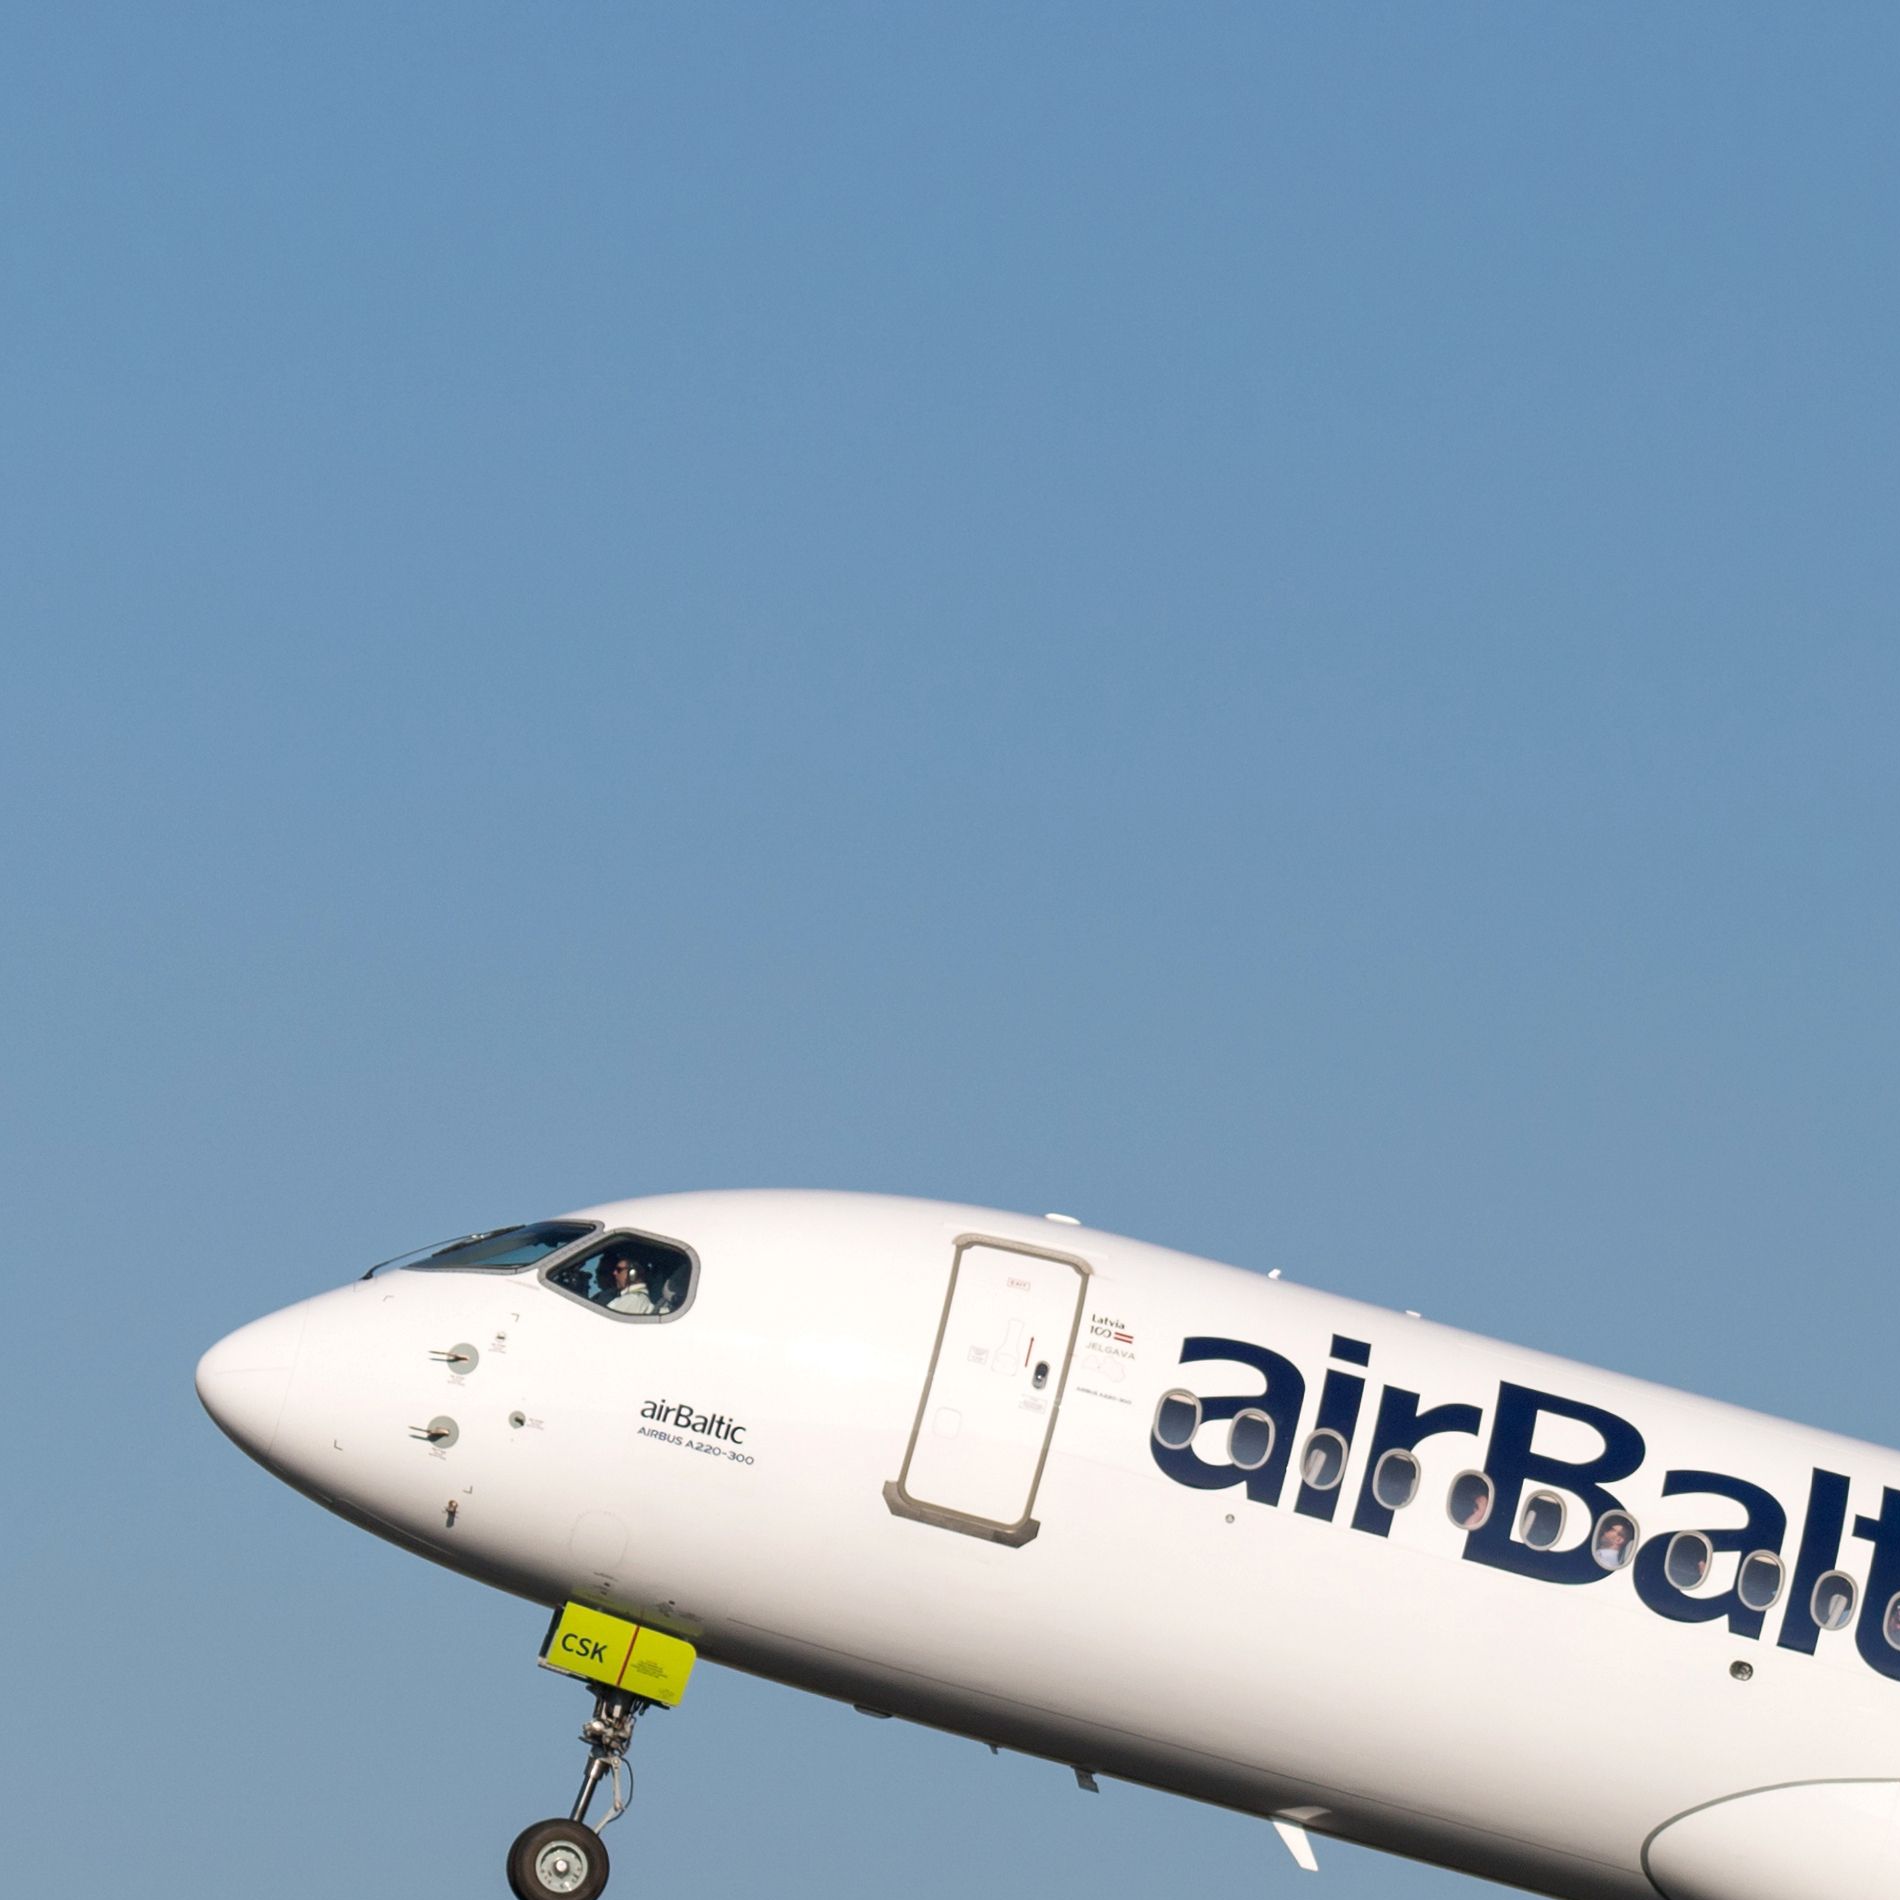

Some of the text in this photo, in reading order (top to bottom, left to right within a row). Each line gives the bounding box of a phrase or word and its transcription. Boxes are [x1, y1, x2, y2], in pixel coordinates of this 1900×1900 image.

[1091, 1312, 1125, 1329] Latvia
[1085, 1341, 1136, 1361] JELGAVA
[639, 1399, 747, 1445] airBaltic
[636, 1426, 756, 1466] AIRBUS A220-300
[561, 1632, 608, 1664] CSK
